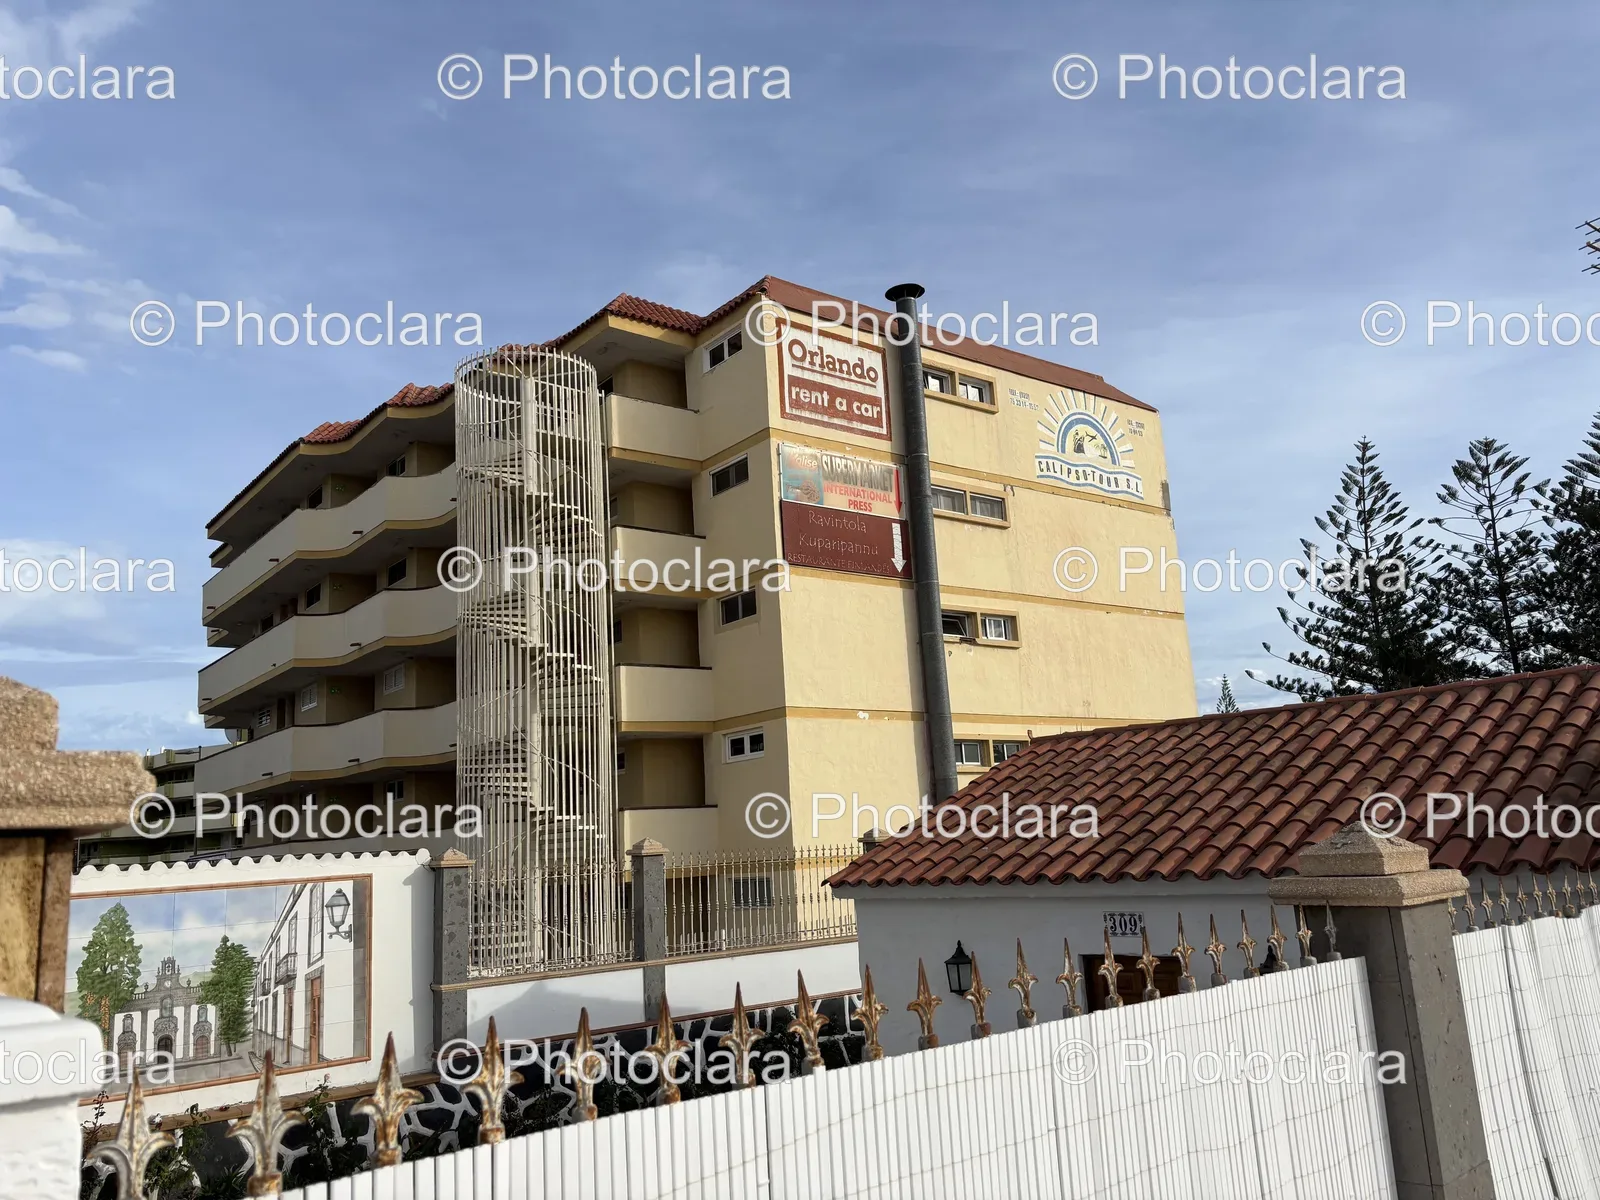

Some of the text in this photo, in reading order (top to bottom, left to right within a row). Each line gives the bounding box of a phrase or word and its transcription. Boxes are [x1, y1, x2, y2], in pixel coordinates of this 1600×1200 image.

[788, 338, 879, 382] Orlando
[791, 385, 880, 418] rent a car
[821, 453, 894, 493] SUPERMARKET
[823, 481, 893, 504] INTERNATIONAL
[847, 498, 873, 513] PRESS
[808, 510, 867, 534] Ravintola
[799, 533, 878, 556] Kuparipannu
[1108, 915, 1138, 933] 309
